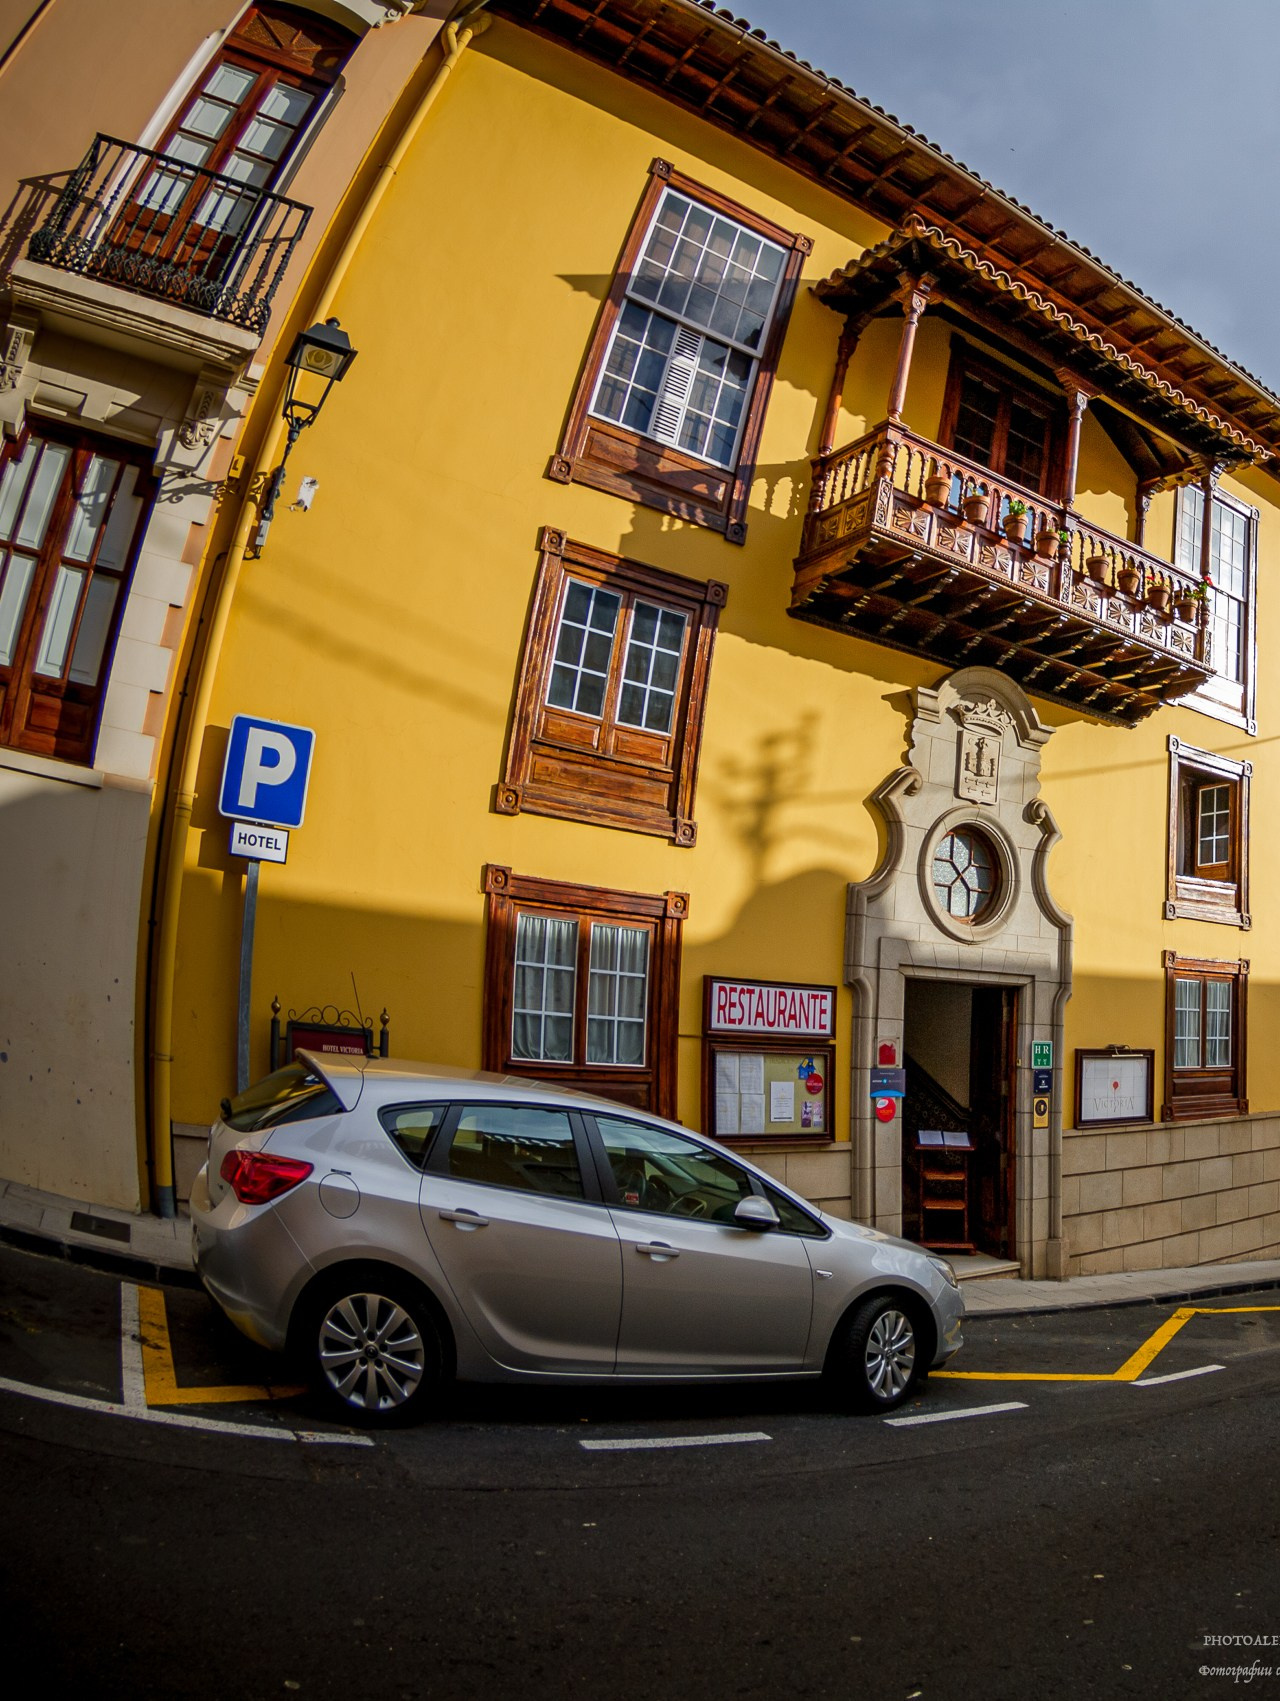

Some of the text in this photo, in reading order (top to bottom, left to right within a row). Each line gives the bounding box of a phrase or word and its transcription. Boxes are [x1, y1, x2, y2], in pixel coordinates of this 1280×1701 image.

[238, 726, 297, 809] P
[238, 832, 281, 851] HOTEL
[716, 985, 828, 1030] RESTAURANTE
[322, 1044, 363, 1055] HOTEL VICTORIA
[1093, 1096, 1134, 1113] VICTORIA
